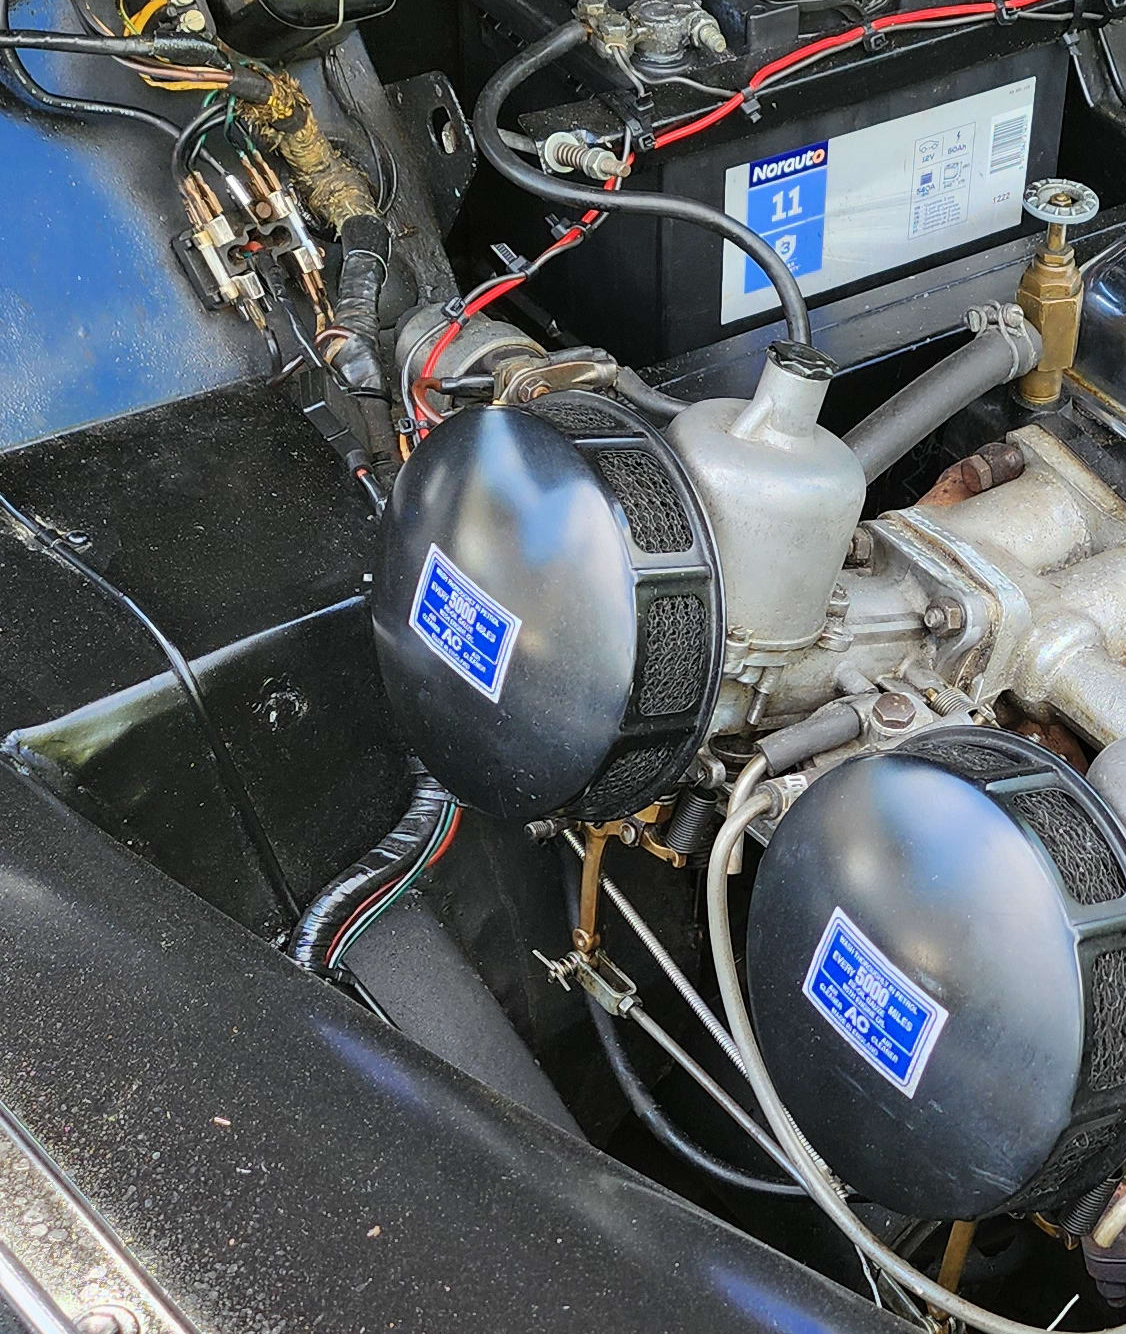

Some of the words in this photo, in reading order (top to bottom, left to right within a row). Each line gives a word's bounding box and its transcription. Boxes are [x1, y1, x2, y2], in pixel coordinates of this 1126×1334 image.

[752, 148, 826, 183] Norauto
[771, 185, 803, 222] 11
[780, 240, 791, 255] 3
[448, 591, 476, 625] 5000
[832, 951, 855, 976] EVERY
[854, 966, 890, 1007] 5000
[888, 1005, 912, 1031] MILES
